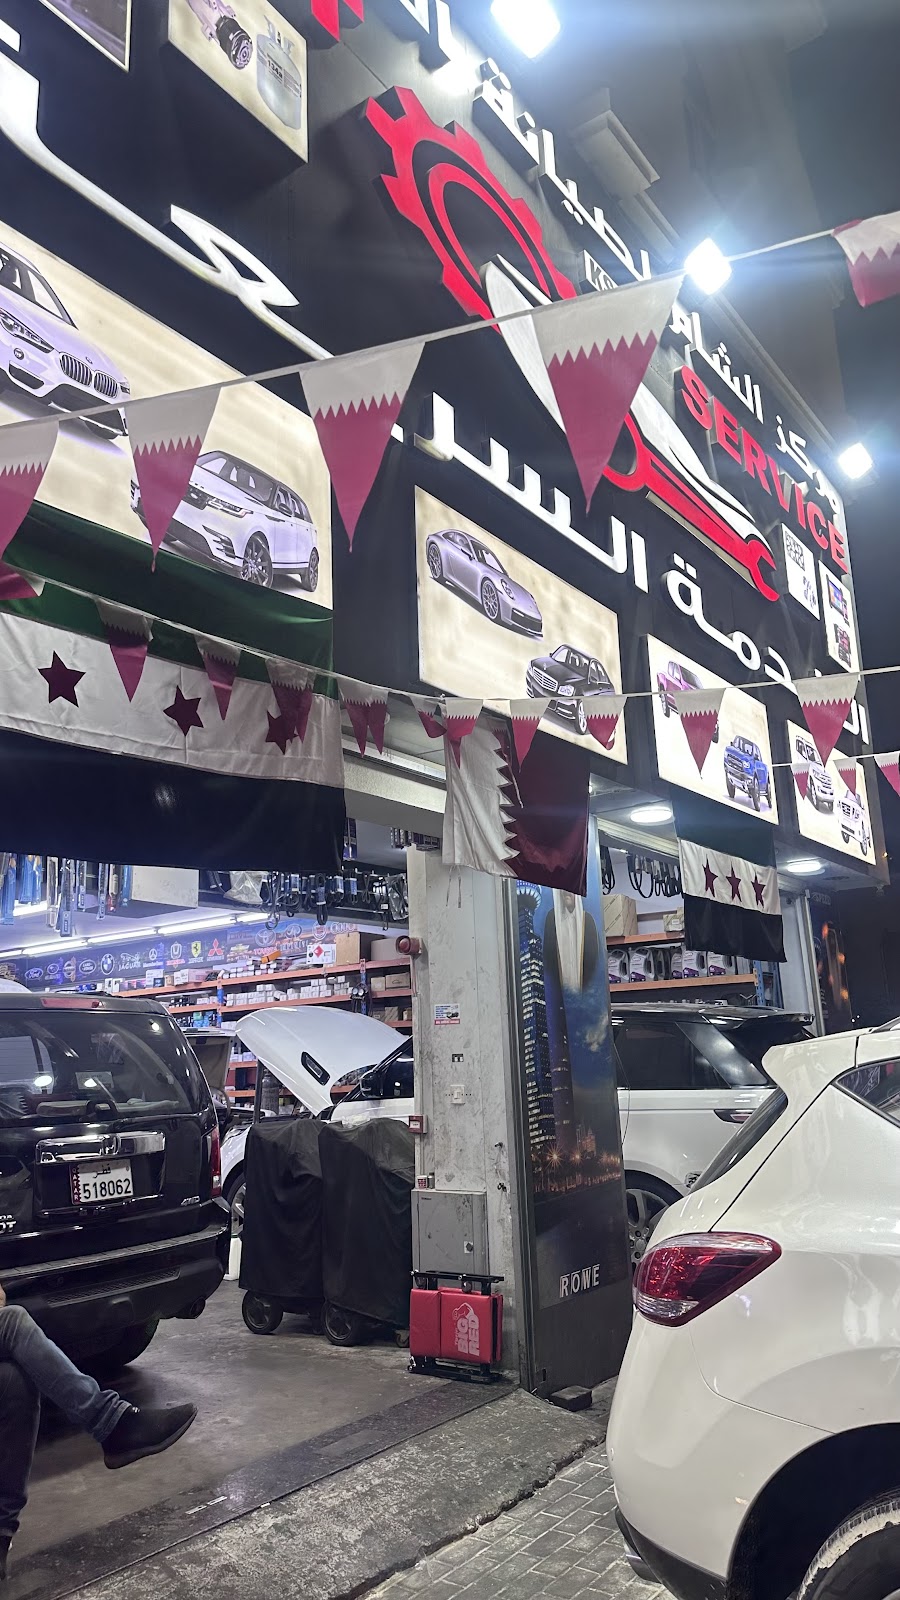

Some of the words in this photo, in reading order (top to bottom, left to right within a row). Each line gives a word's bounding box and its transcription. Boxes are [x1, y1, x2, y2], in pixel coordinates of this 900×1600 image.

[681, 364, 850, 574] SERVICE
[666, 553, 870, 746] الدمة
[71, 1167, 80, 1201] QATAR
[82, 1178, 132, 1200] 518062
[93, 1163, 112, 1179] قطر
[560, 1263, 601, 1298] ROWE
[456, 1317, 469, 1354] BIG
[468, 1314, 480, 1357] RED
